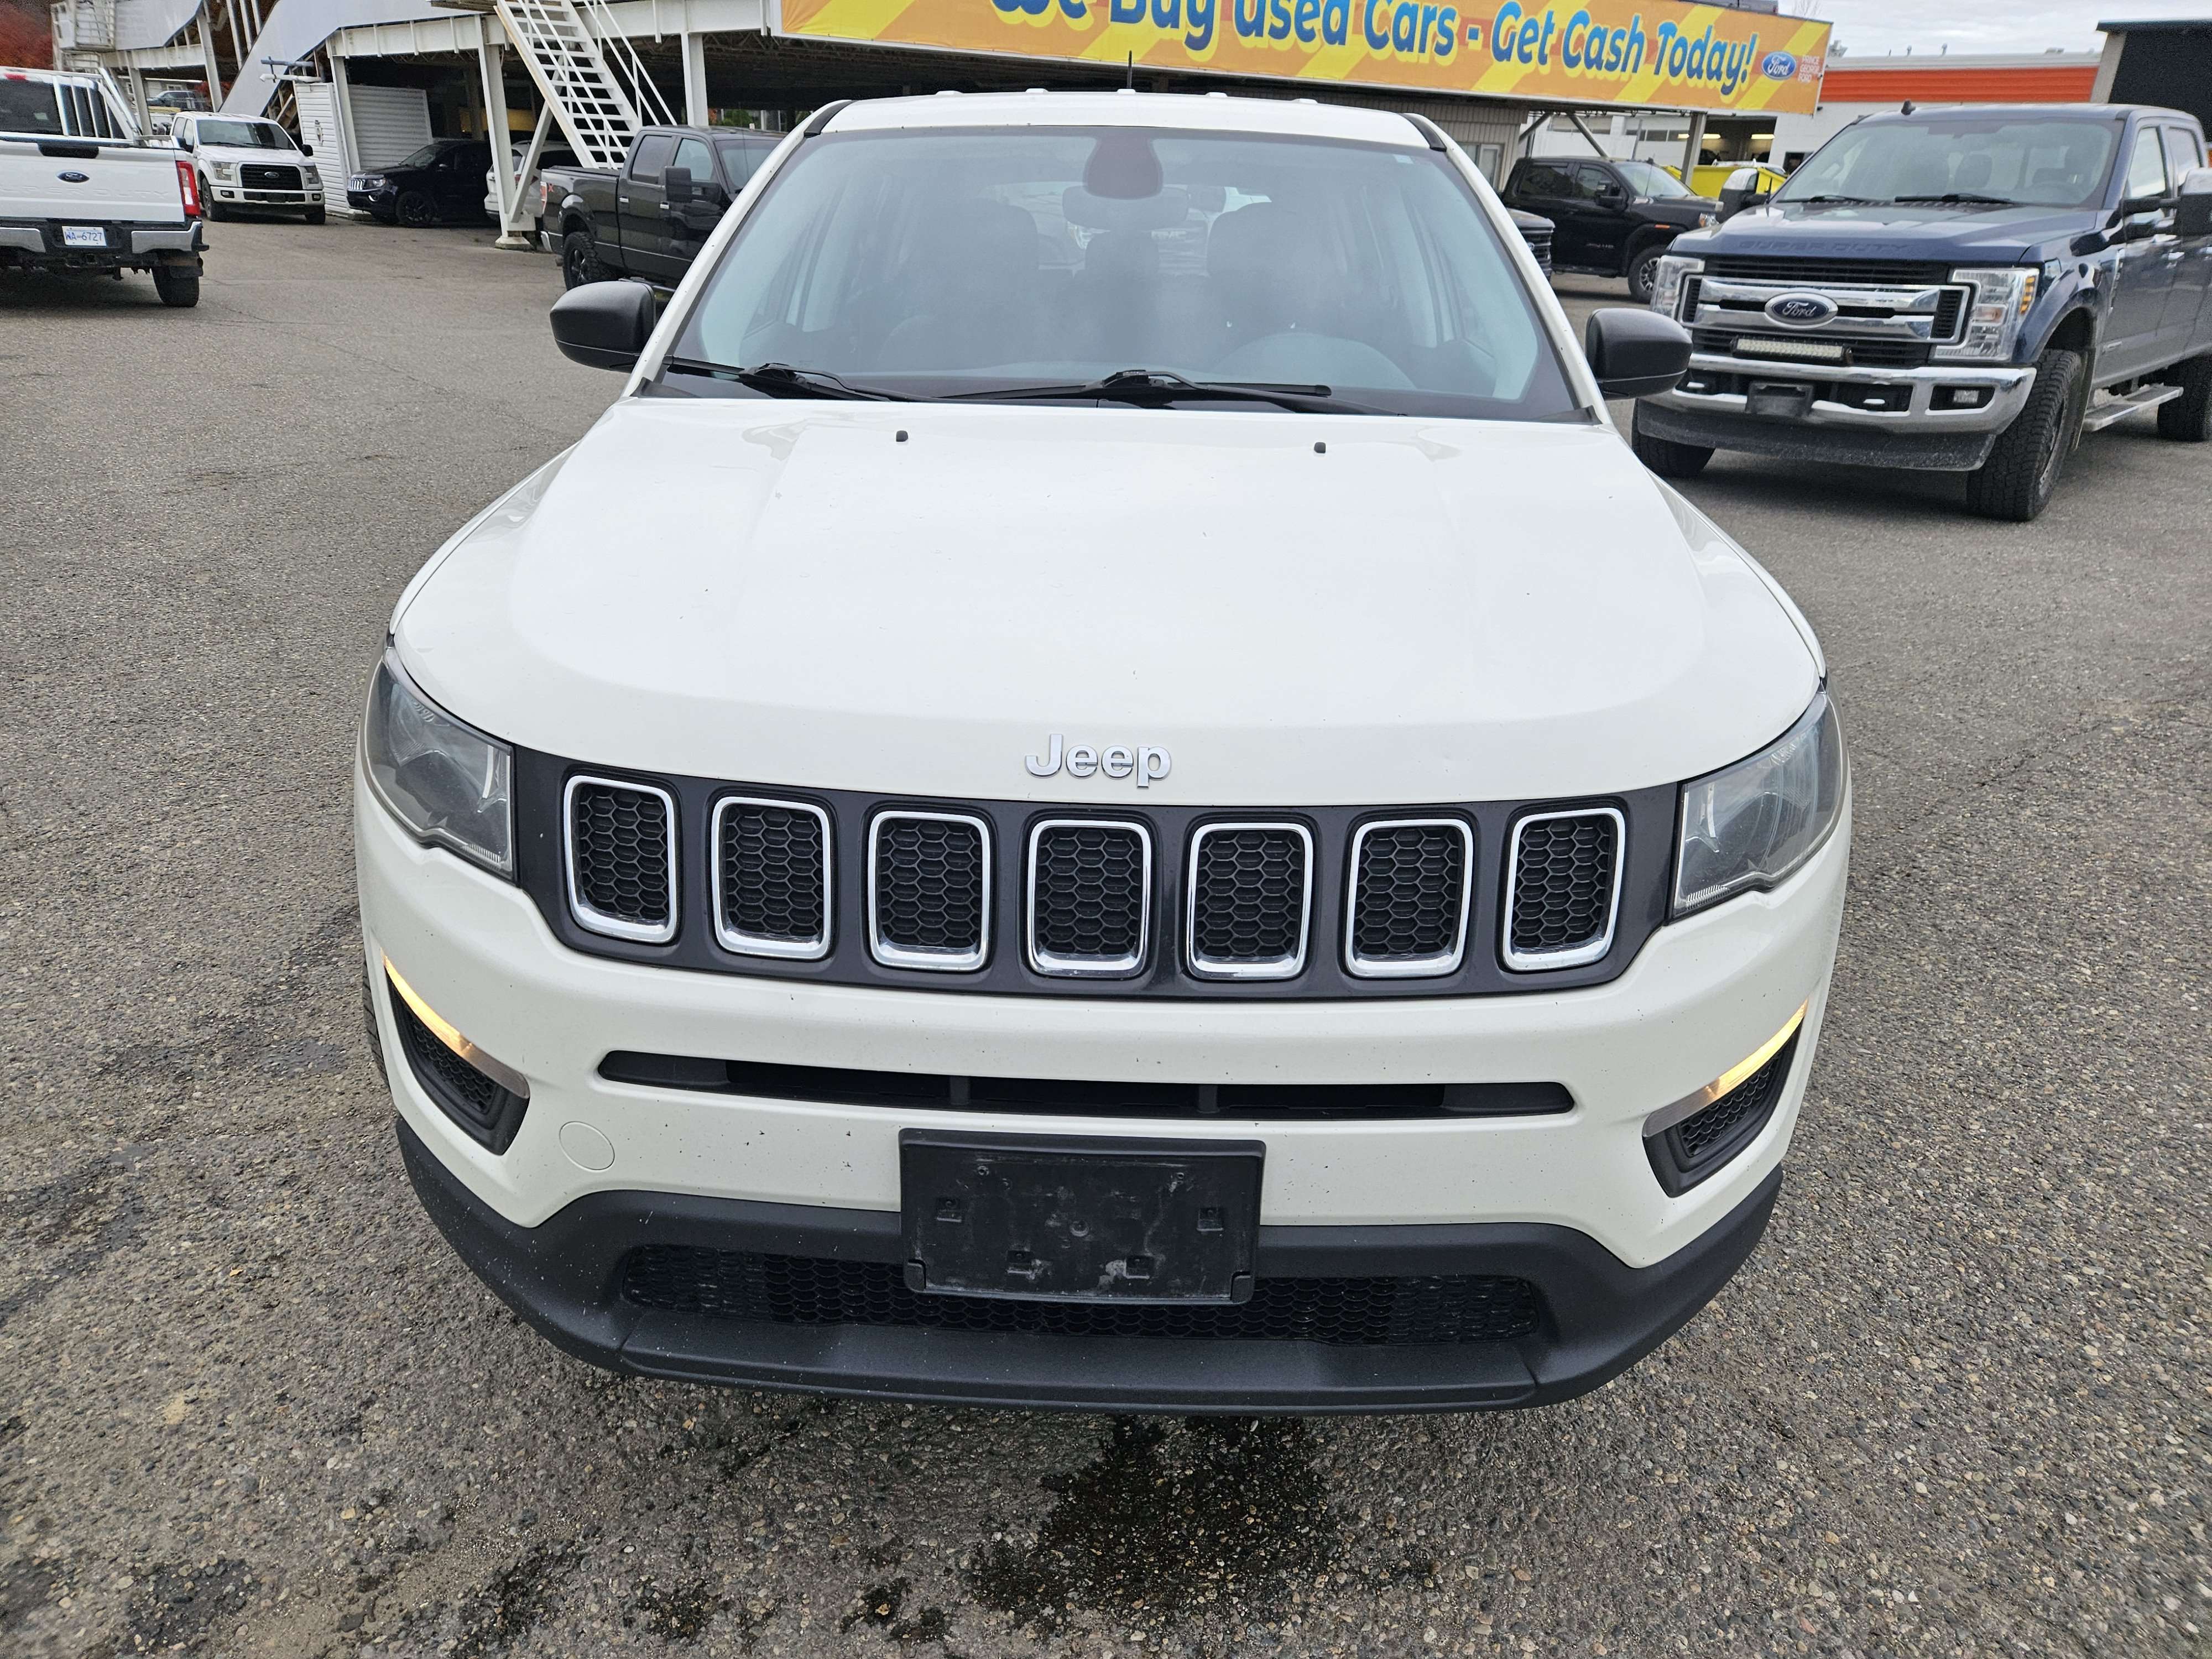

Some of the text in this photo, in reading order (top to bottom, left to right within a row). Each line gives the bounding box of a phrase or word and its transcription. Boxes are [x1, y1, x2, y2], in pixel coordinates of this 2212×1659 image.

[1364, 0, 1458, 56] Cars
[1491, 1, 1555, 65] Get
[1563, 10, 1645, 74] Cash
[1654, 22, 1759, 96] Today!
[1767, 56, 1791, 76] Ford
[65, 232, 102, 242] WA-6727
[1782, 300, 1817, 317] Ford
[1025, 734, 1172, 790] Jeep
